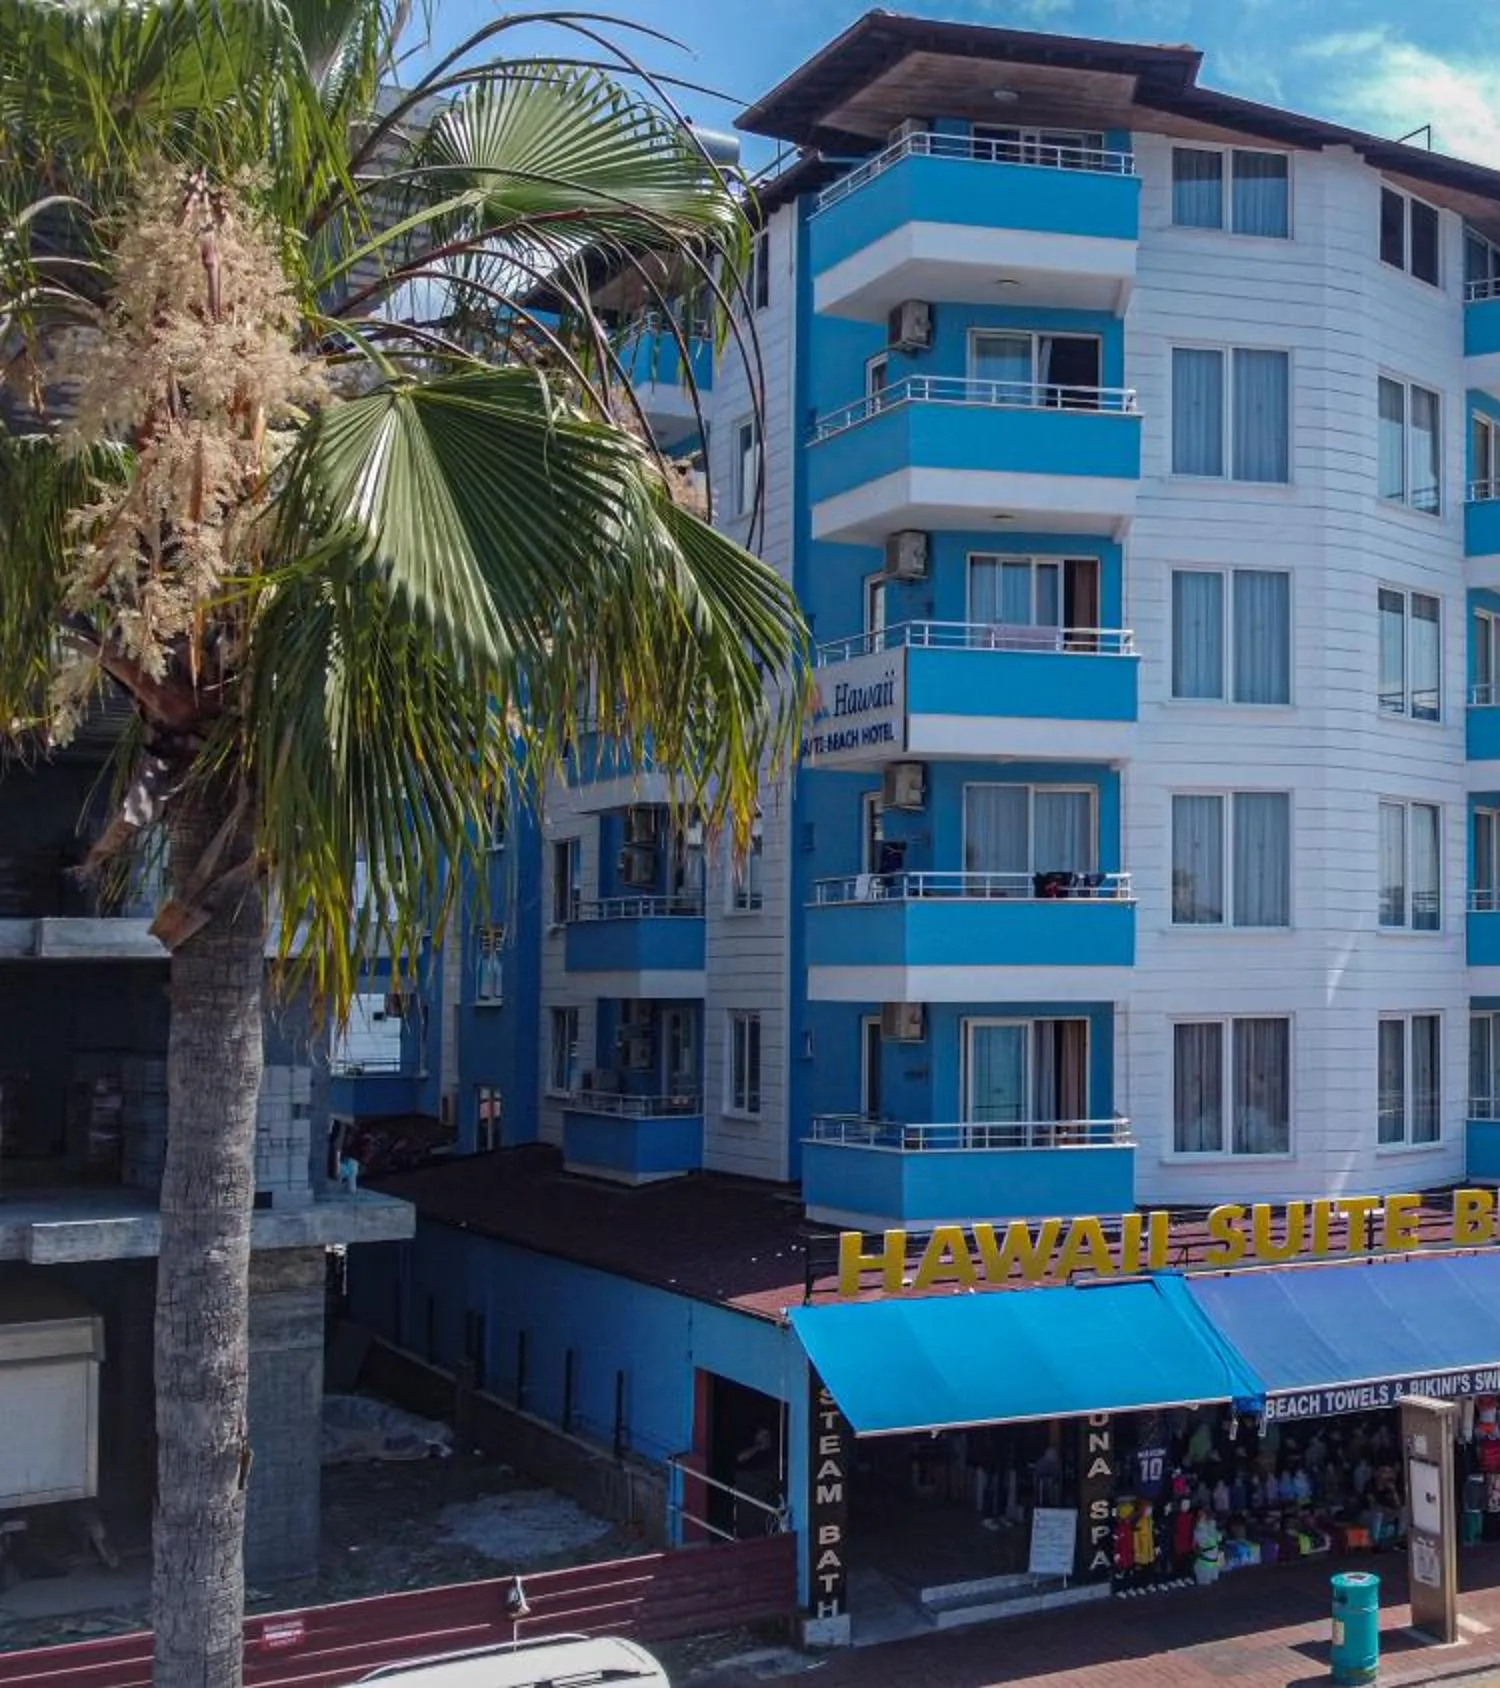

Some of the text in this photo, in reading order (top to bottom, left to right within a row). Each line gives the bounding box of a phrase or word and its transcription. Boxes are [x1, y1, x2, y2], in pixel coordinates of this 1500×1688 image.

[832, 669, 895, 717] Hawaii
[861, 721, 895, 746] HOTEL
[837, 1210, 1170, 1297] HAWAII
[1204, 1193, 1422, 1267] SUITE
[1265, 1396, 1321, 1421] BEACH
[1325, 1384, 1390, 1412] TOWELS
[1087, 1413, 1112, 1571] UNA SPA
[1139, 1458, 1164, 1482] 10
[816, 1525, 842, 1619] BATH
